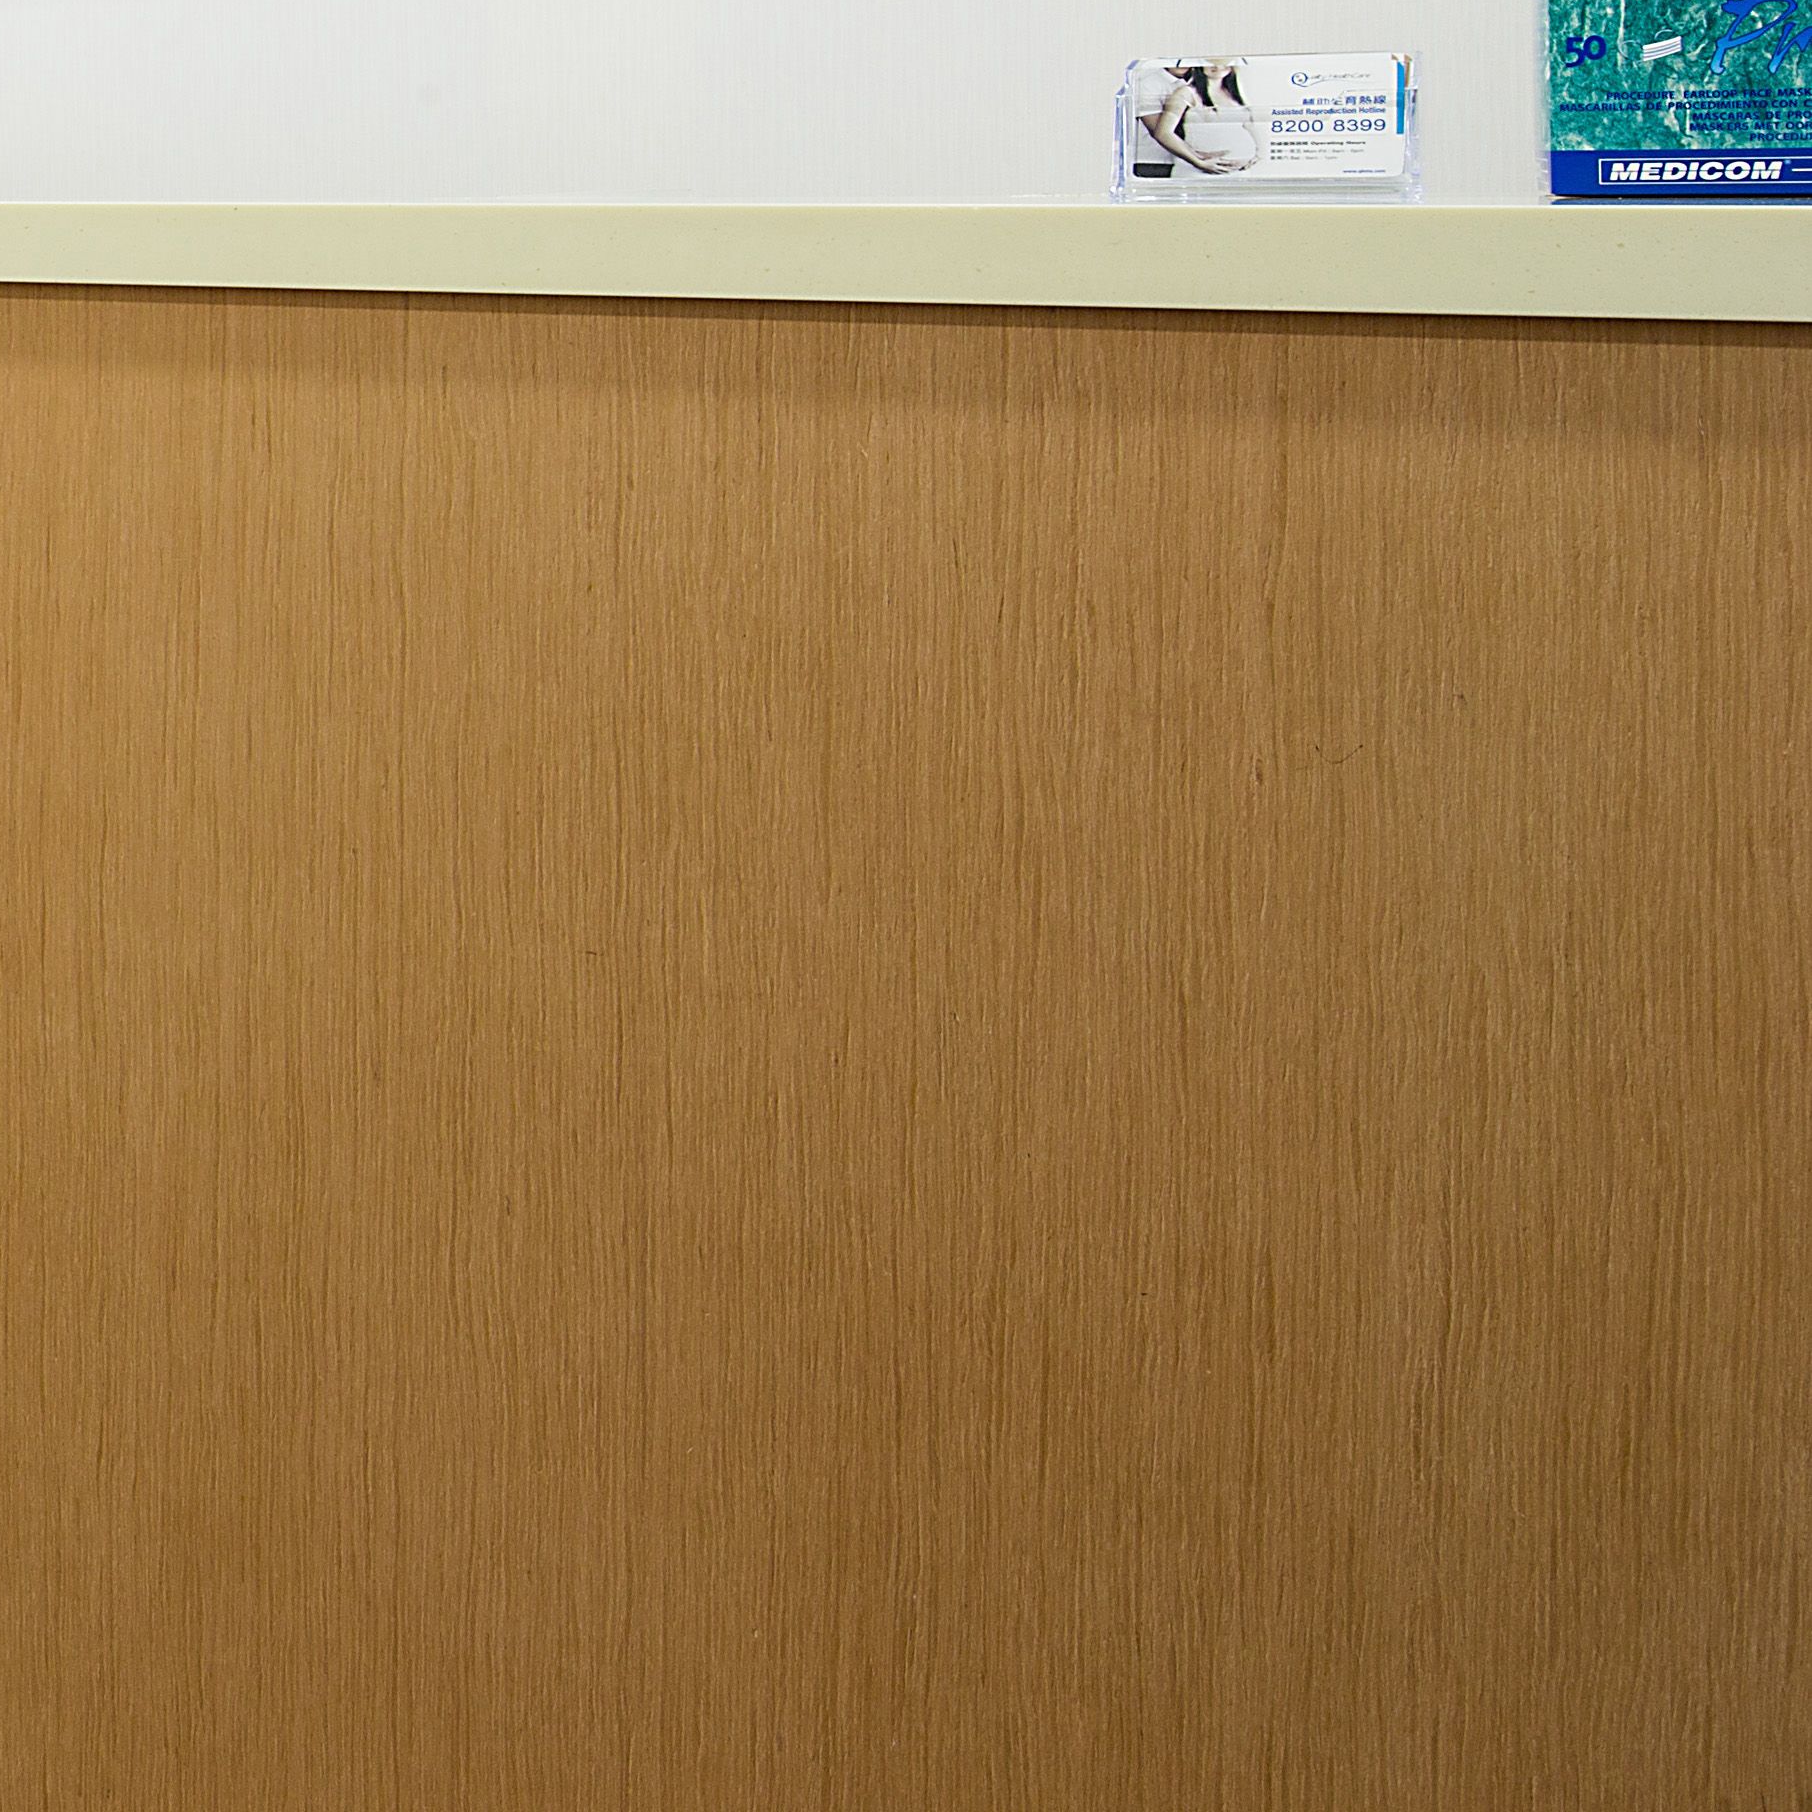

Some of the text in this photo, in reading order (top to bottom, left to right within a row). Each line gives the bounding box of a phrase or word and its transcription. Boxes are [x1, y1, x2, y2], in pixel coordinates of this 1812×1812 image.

[1564, 35, 1607, 68] 50
[1606, 90, 1675, 100] PROCEDURE
[1683, 89, 1737, 99] EARLOOP
[1743, 88, 1772, 98] FACE
[1272, 108, 1303, 116] Assisted
[1306, 106, 1356, 116] Reproduction
[1560, 99, 1798, 112] MASCARILLAS DE PROCEDIMIENTO CON
[1766, 111, 1782, 120] DE
[1271, 118, 1386, 133] 8200 8399
[1609, 160, 1783, 181] MEDICOM
